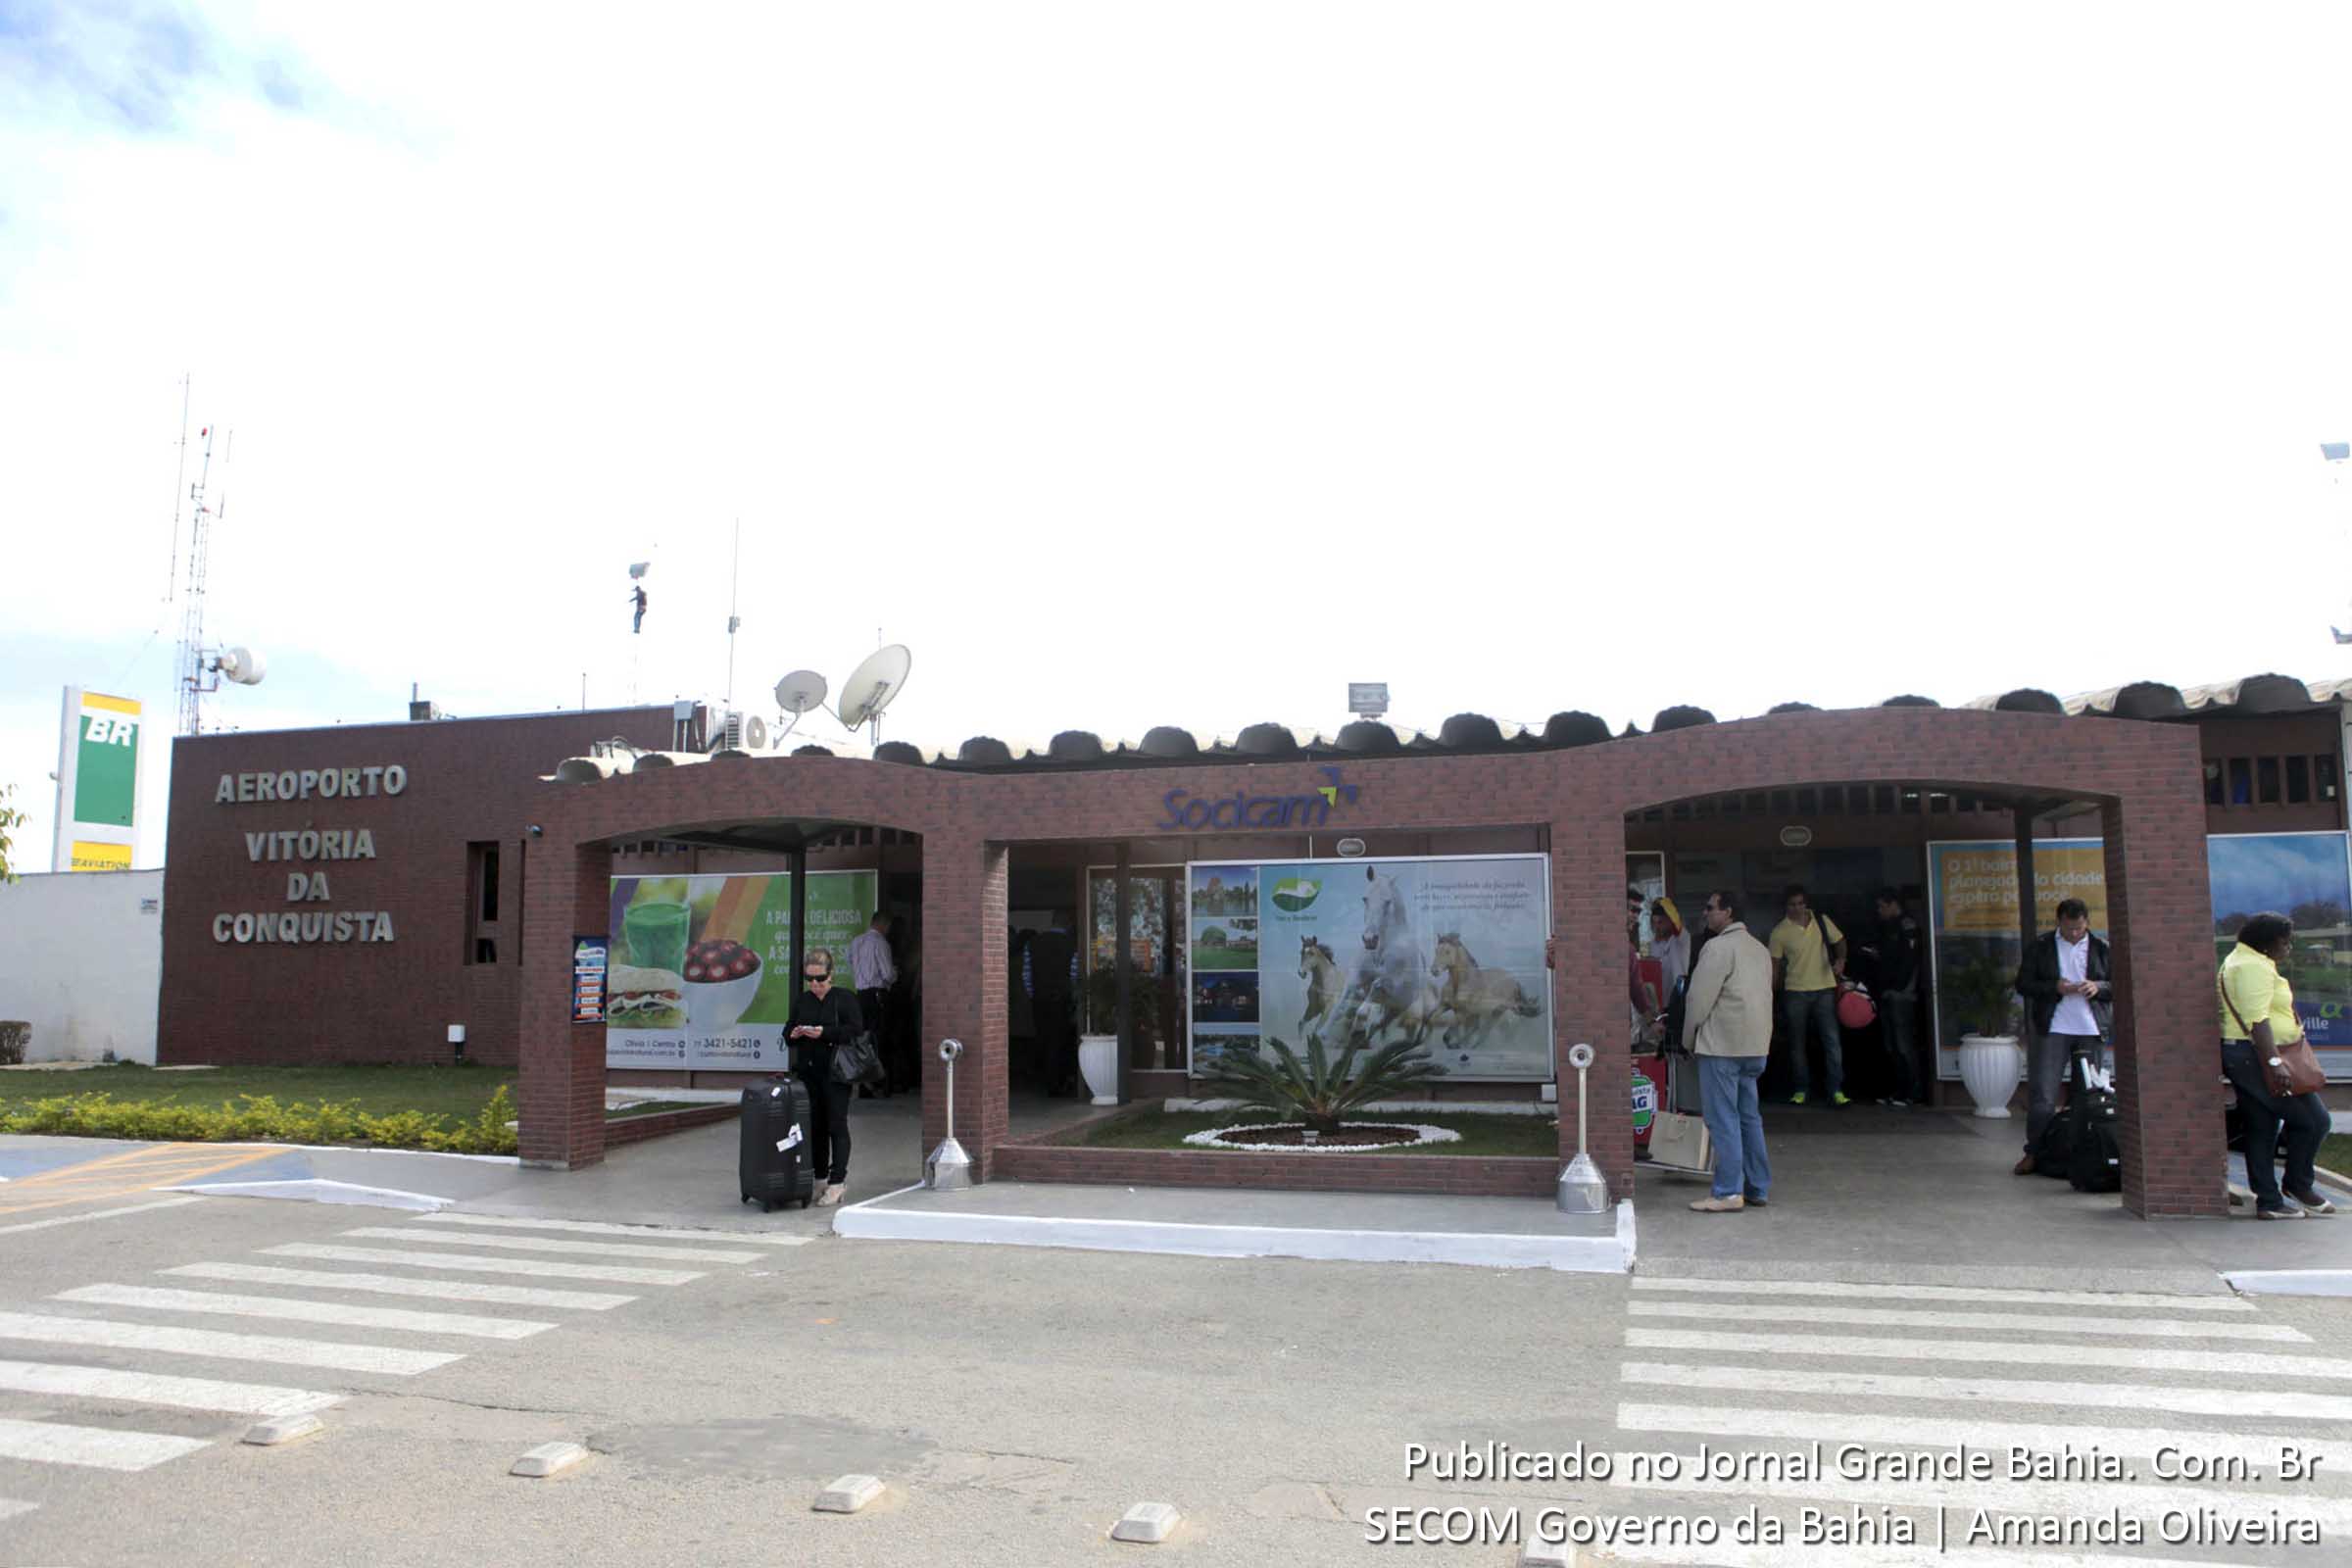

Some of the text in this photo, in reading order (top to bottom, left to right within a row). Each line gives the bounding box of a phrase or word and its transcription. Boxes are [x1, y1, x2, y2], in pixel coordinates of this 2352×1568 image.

[85, 715, 134, 747] BR
[215, 764, 408, 804] AEROPORTO
[1158, 788, 1330, 831] Socicam
[245, 819, 376, 862] VITÓRIA
[286, 871, 331, 902] DA
[212, 910, 395, 944] CONQUISTA
